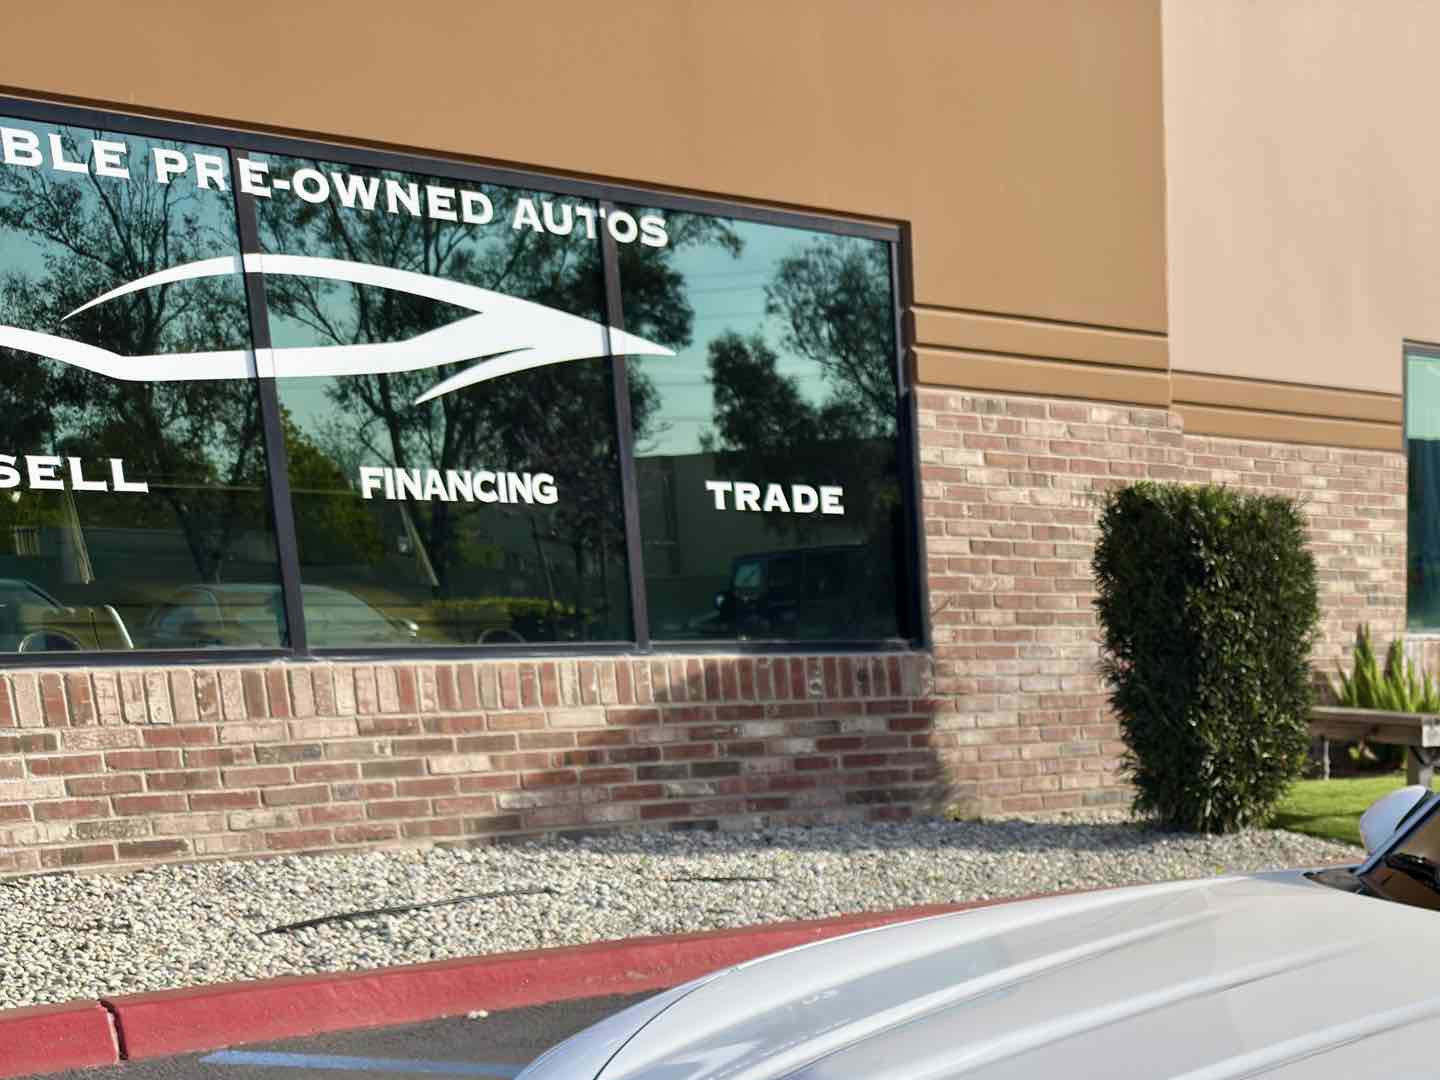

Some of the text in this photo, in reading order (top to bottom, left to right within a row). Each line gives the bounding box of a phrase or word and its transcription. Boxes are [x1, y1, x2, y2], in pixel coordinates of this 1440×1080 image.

[0, 126, 669, 248] BLE PRE-OWNED AUTOS
[359, 466, 559, 505] FINANCING
[705, 480, 845, 515] TRADE
